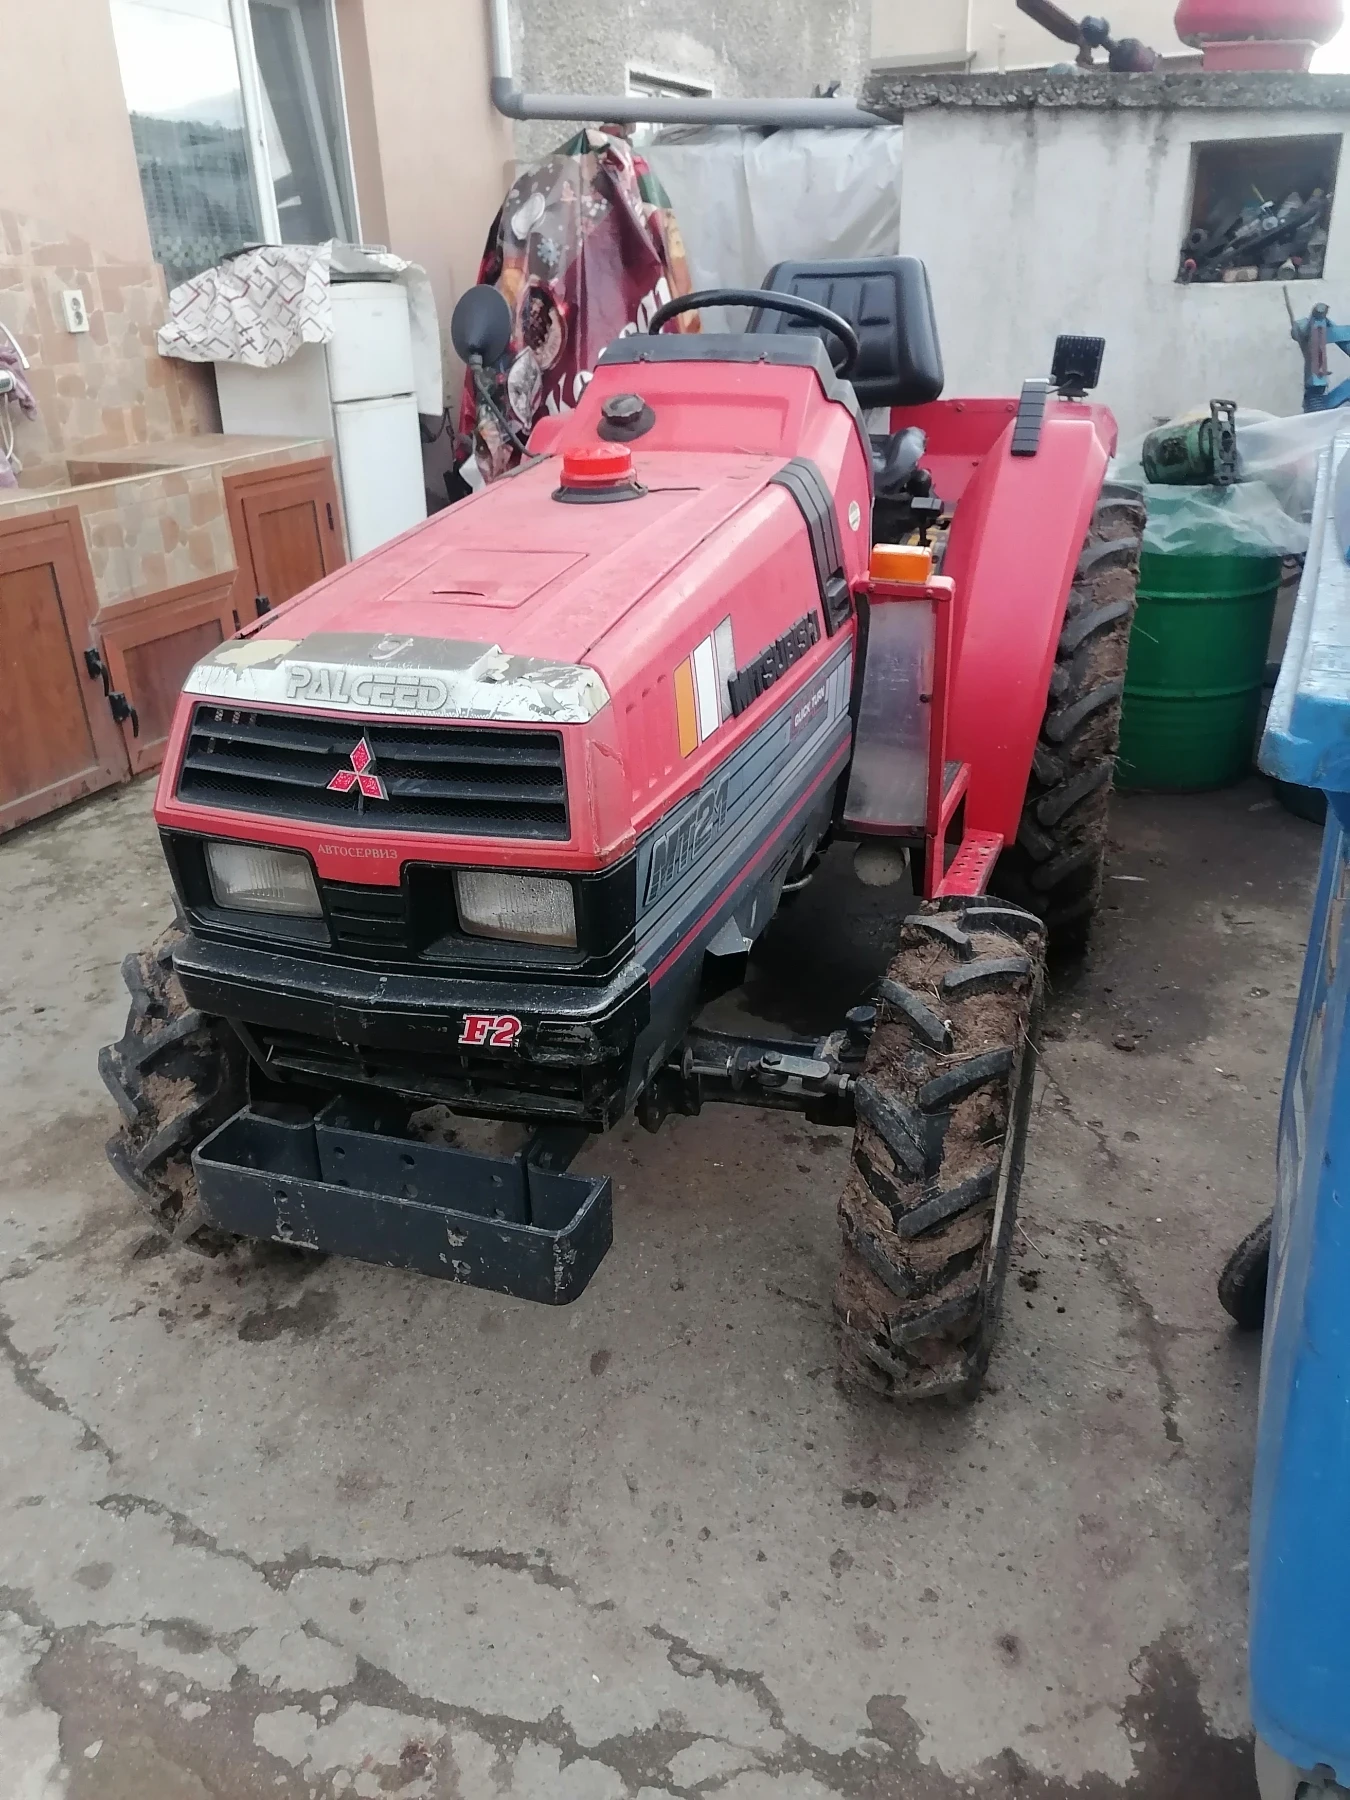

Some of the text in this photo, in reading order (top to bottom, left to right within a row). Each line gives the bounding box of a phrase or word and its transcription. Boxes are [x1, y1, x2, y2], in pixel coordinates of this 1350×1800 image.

[286, 665, 449, 711] PALCEED
[317, 844, 398, 859] АВТОСЕРВИЗ
[457, 1013, 523, 1048] F2
